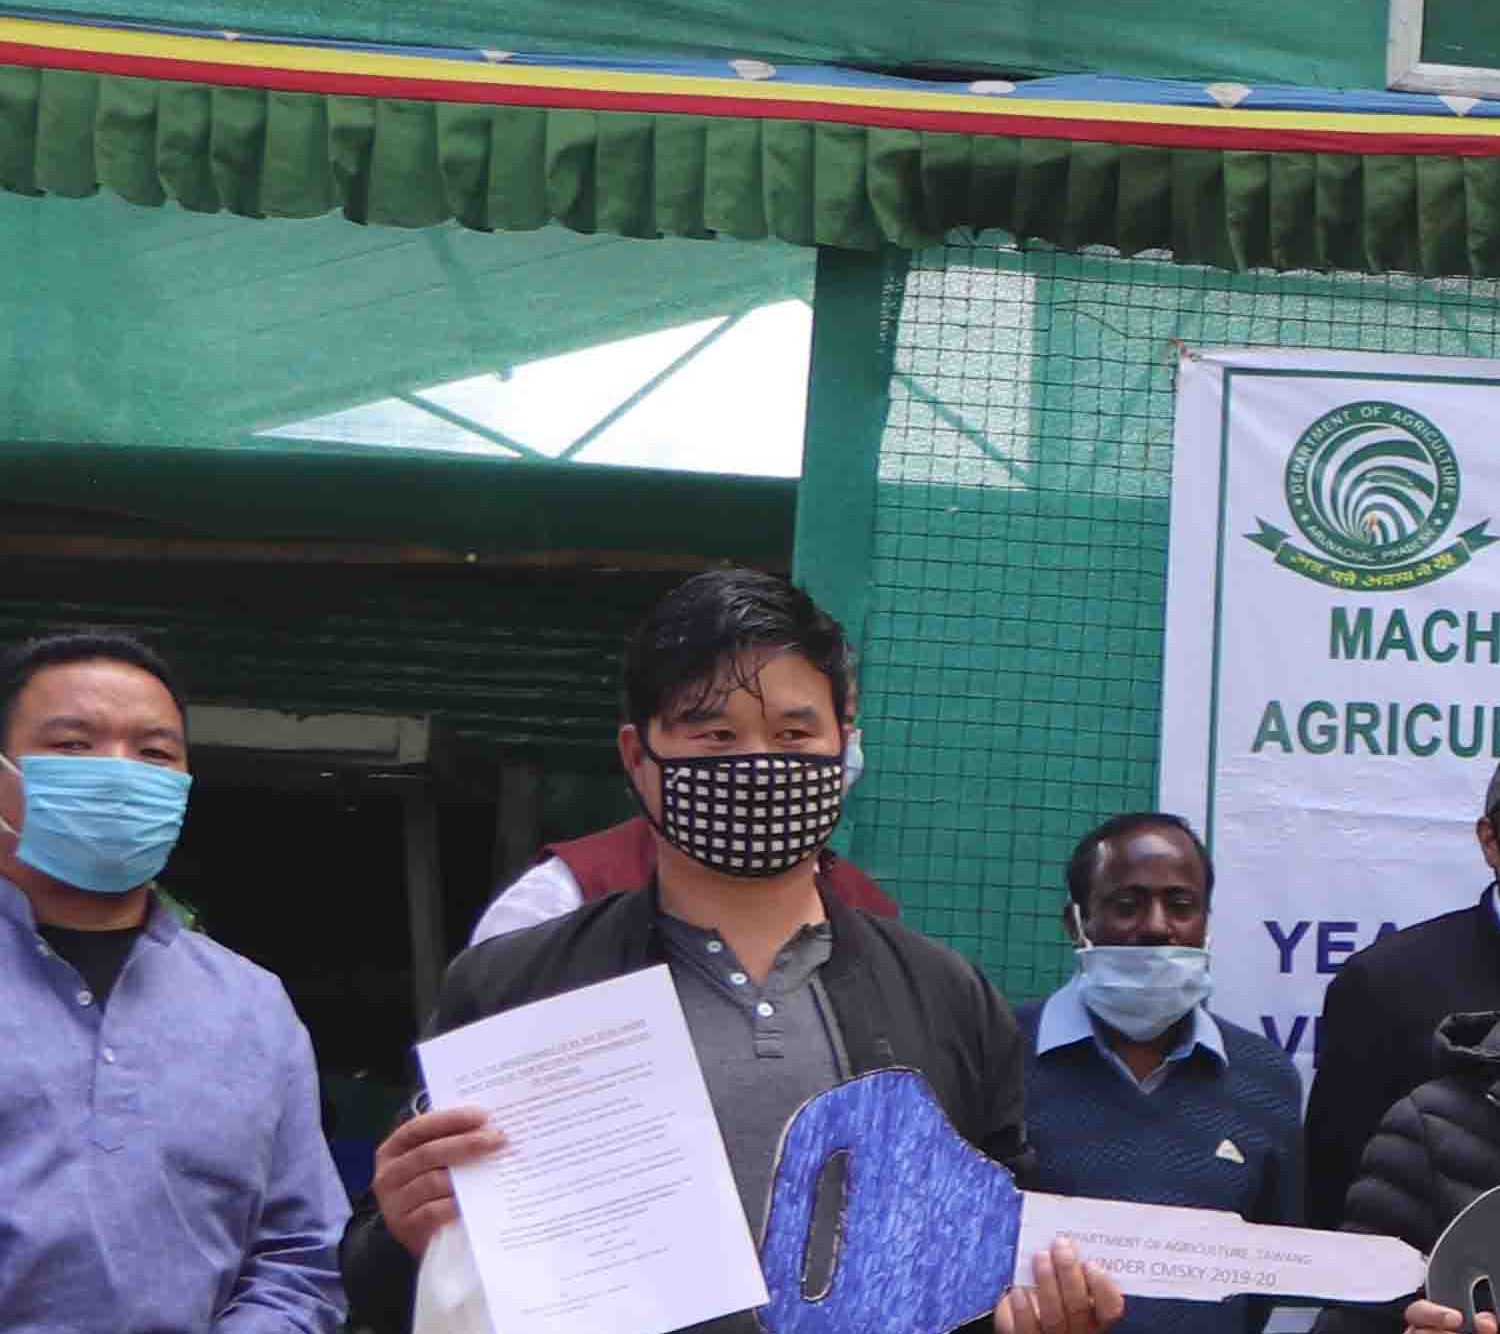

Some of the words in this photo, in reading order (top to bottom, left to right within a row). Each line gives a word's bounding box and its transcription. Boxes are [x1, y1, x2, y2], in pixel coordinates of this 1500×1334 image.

[1360, 406, 1384, 418] OF
[1391, 409, 1457, 491] AGRICULTURE
[1092, 1258, 1146, 1276] NDER
